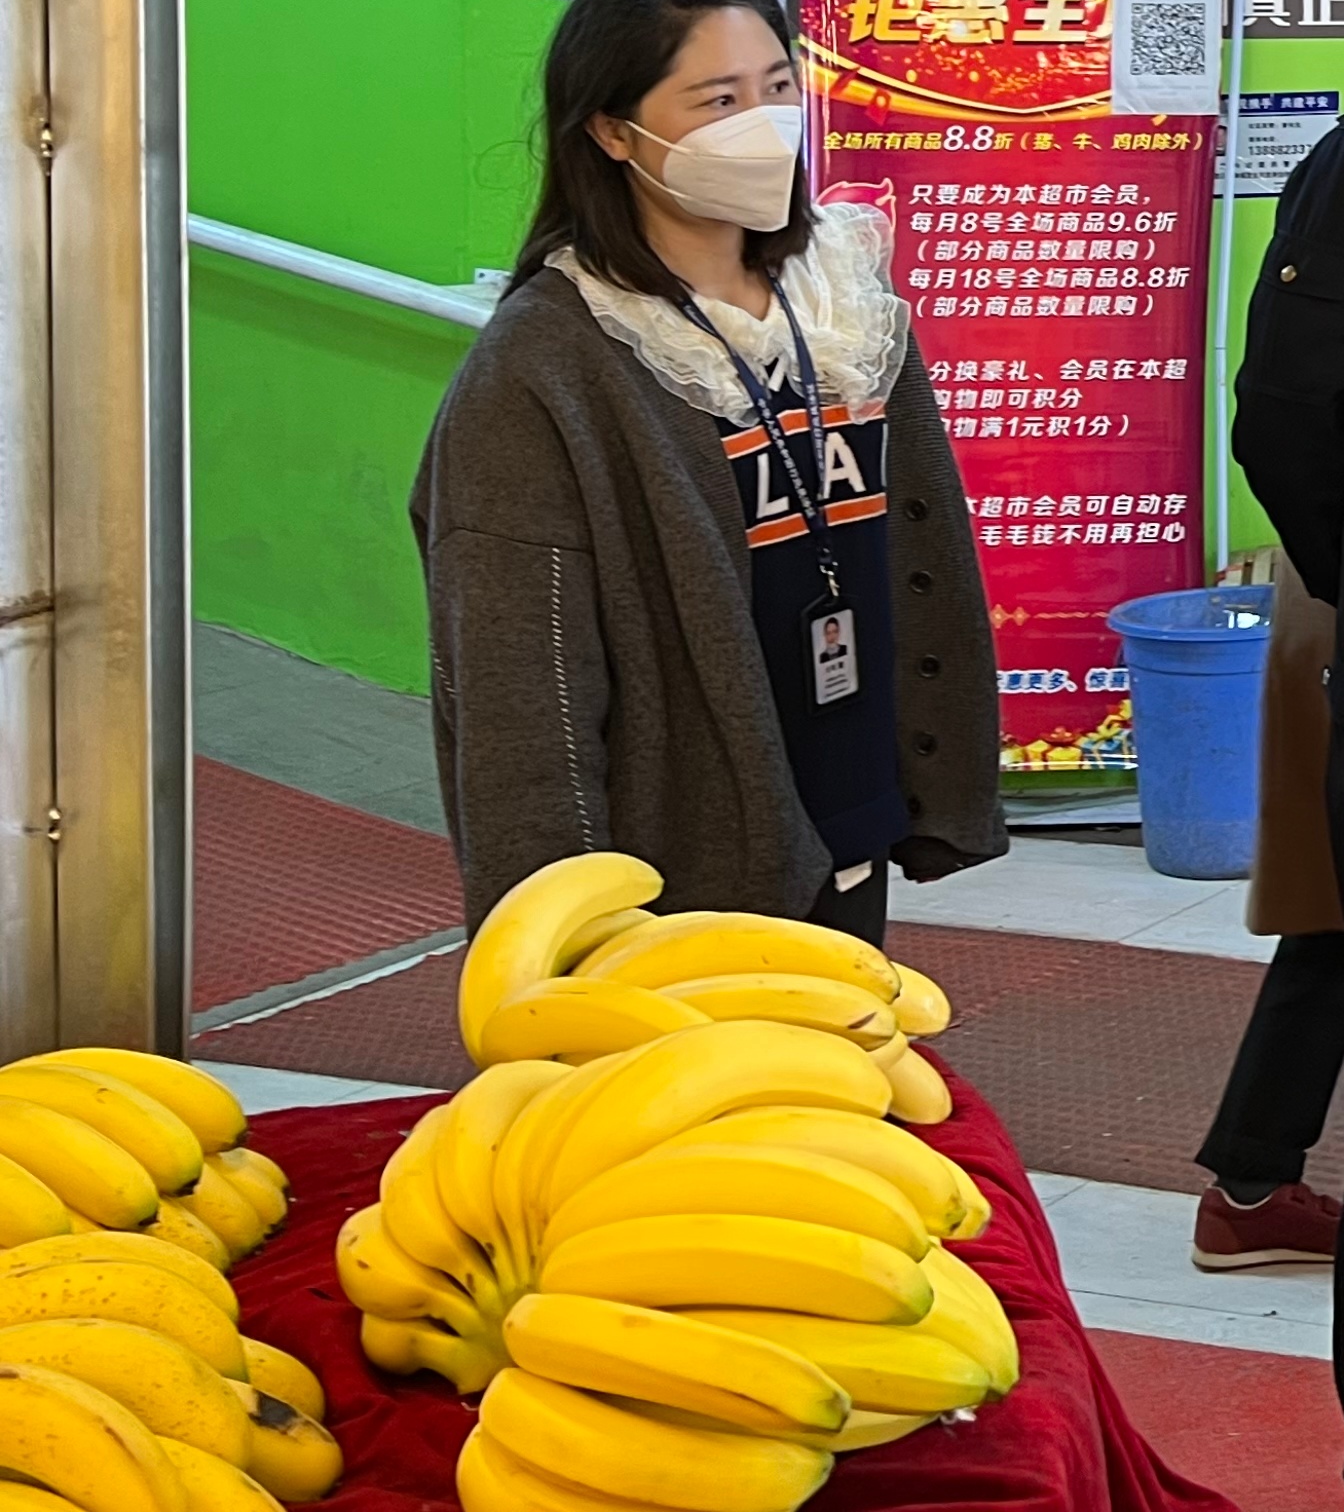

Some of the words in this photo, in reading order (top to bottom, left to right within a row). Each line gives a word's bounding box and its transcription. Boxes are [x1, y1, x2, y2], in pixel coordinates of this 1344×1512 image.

[908, 184, 1151, 206] 只要成为本超市会员，
[909, 212, 1178, 234] 每月8号全场商品9.6折
[916, 239, 1156, 262] （部分商品数量限购）
[908, 267, 1191, 290] 每月18号全场商品8.8折
[915, 294, 1155, 318] （部分商品数量限购）
[979, 522, 1186, 546] 毛毛钱不用再担心
